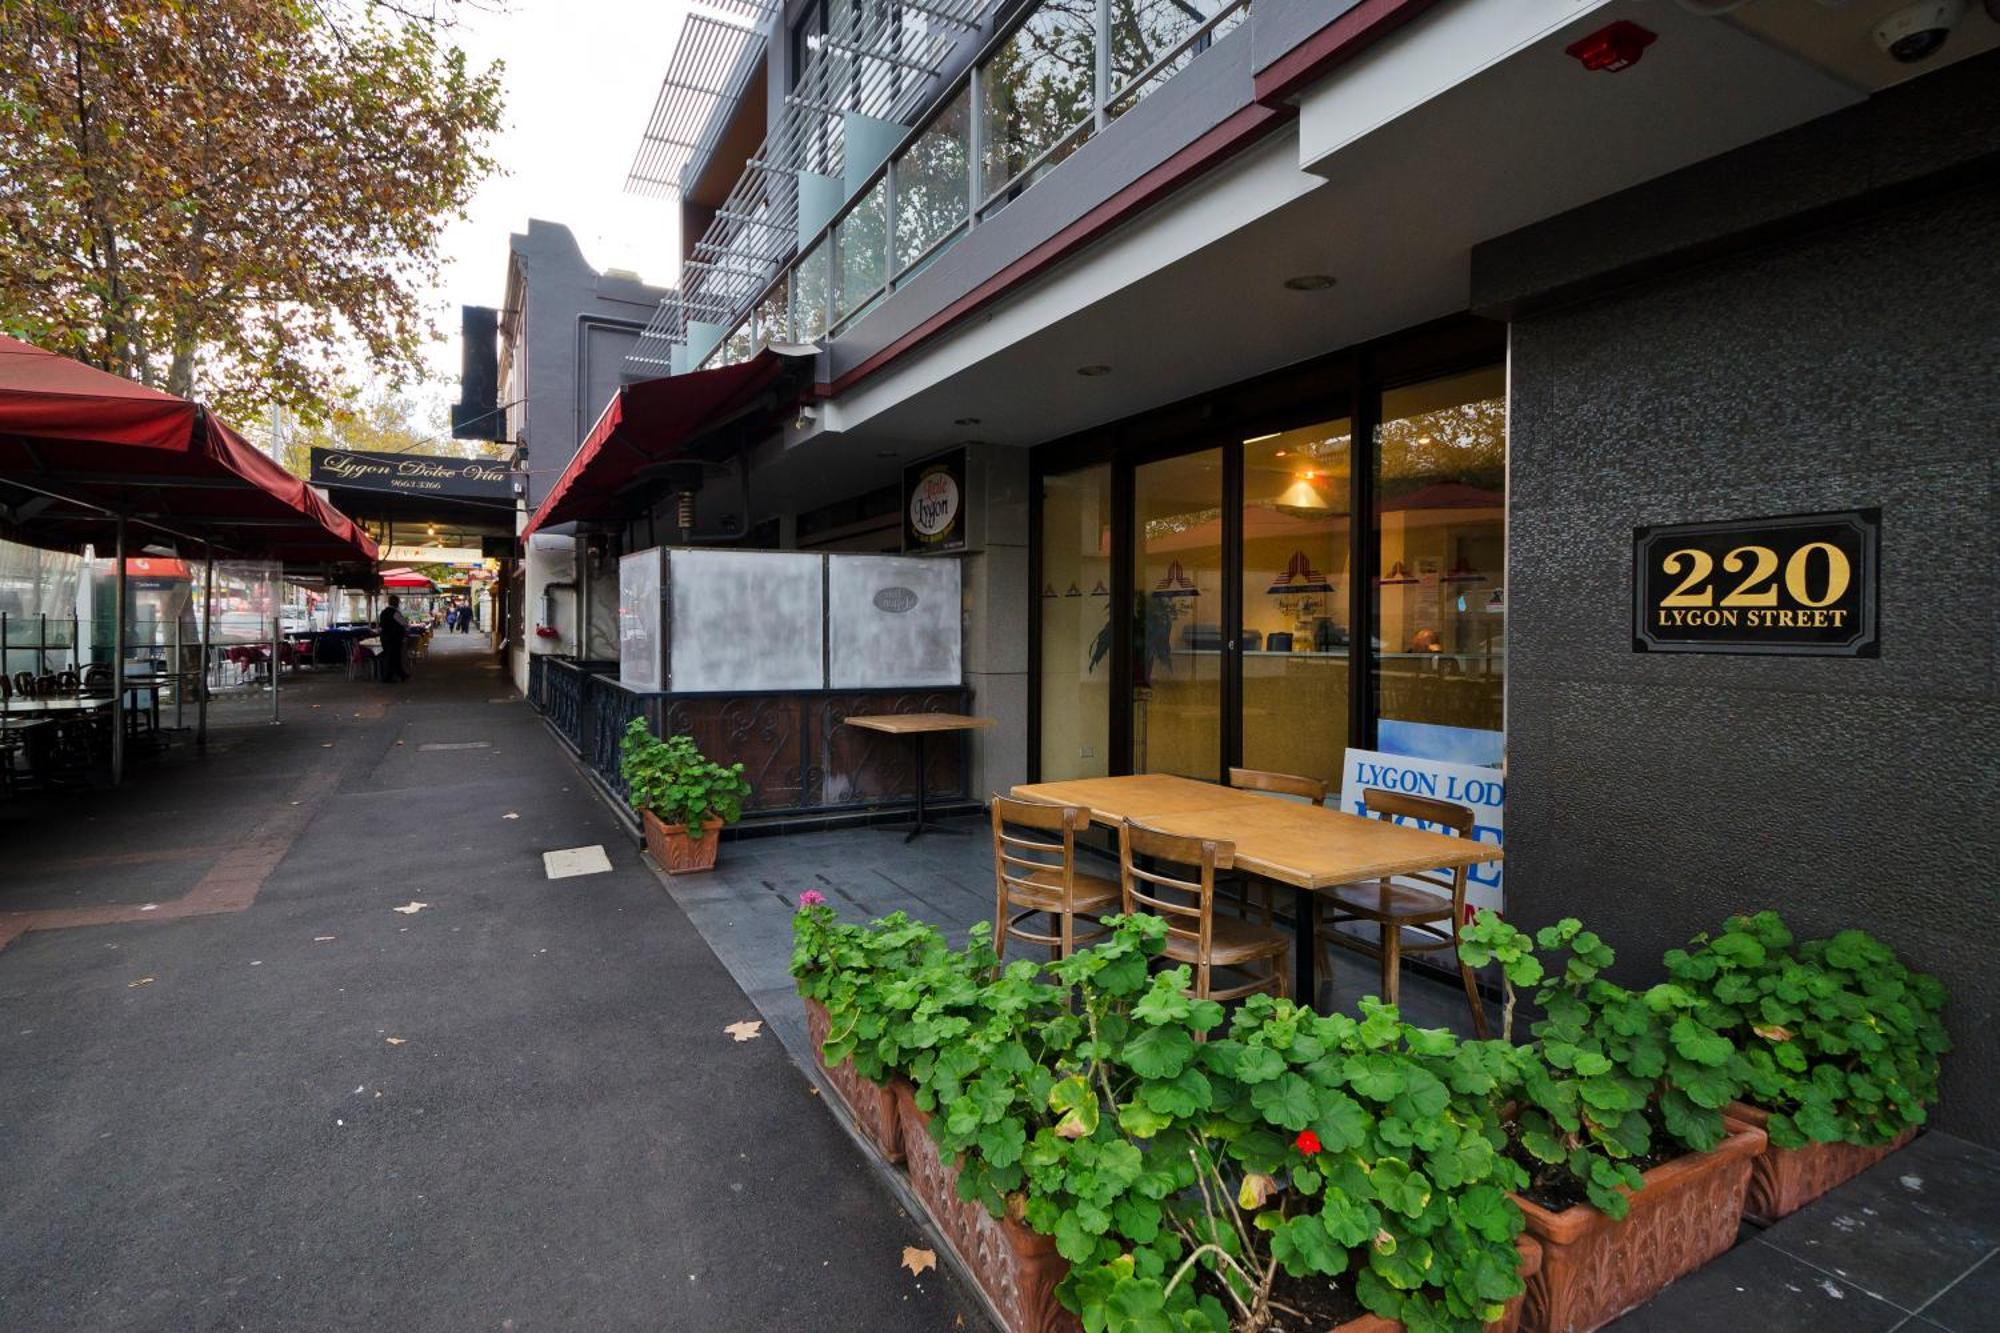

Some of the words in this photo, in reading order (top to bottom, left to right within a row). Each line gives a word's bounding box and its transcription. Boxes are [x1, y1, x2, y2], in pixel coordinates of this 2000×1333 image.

[320, 454, 392, 479] Lygon
[396, 460, 456, 478] Dolce
[463, 464, 505, 481] Vita
[1659, 541, 1851, 608] 220
[1658, 609, 1738, 627] LYGON
[1747, 609, 1848, 628] STREET
[1355, 762, 1439, 796] LYGON
